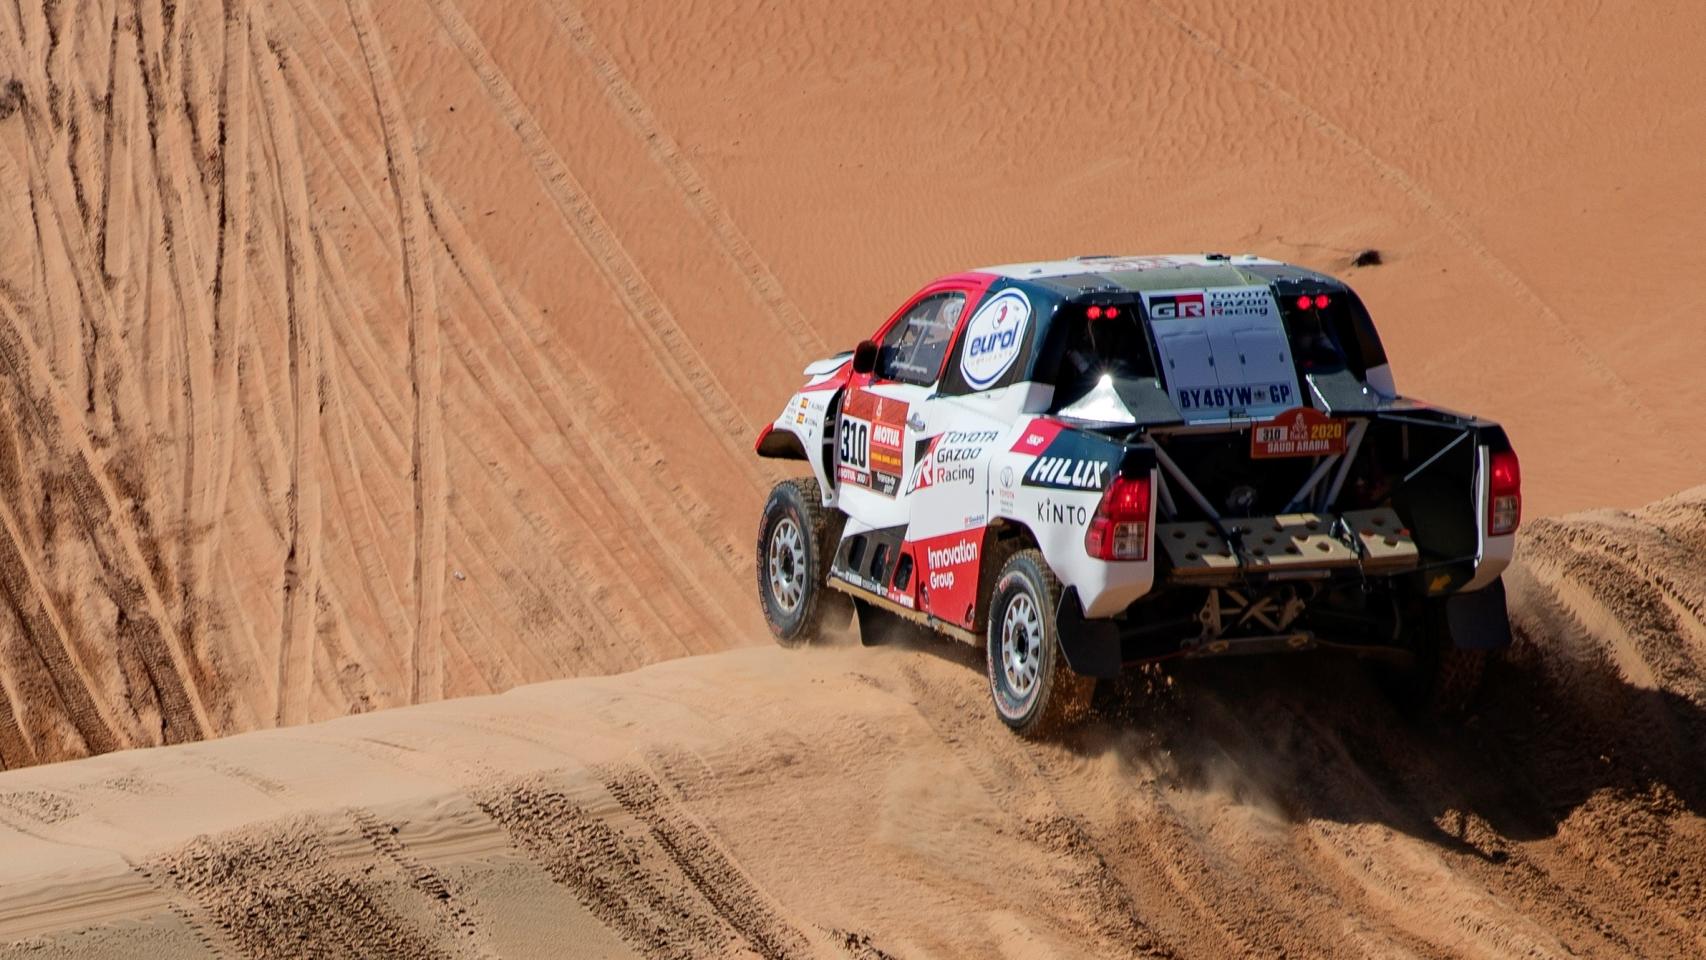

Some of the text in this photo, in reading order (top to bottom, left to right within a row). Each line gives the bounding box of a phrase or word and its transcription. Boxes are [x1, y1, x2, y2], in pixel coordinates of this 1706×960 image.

[1210, 299, 1268, 308] GAZOO
[1211, 290, 1272, 300] TOYOTA
[1211, 307, 1269, 317] Racing
[970, 320, 1020, 357] eurol
[1269, 384, 1291, 404] GP
[873, 424, 901, 448] MOTUL
[944, 430, 999, 444] TOYOTA
[1263, 426, 1282, 441] 310
[1310, 424, 1343, 440] 2020
[841, 418, 868, 468] 310
[1267, 439, 1330, 454] SAUDI ARABIA
[937, 447, 982, 464] GAZOO
[937, 464, 975, 485] Racing
[1030, 456, 1109, 489] HILUX
[927, 538, 978, 571] Innovation
[929, 570, 955, 590] Group
